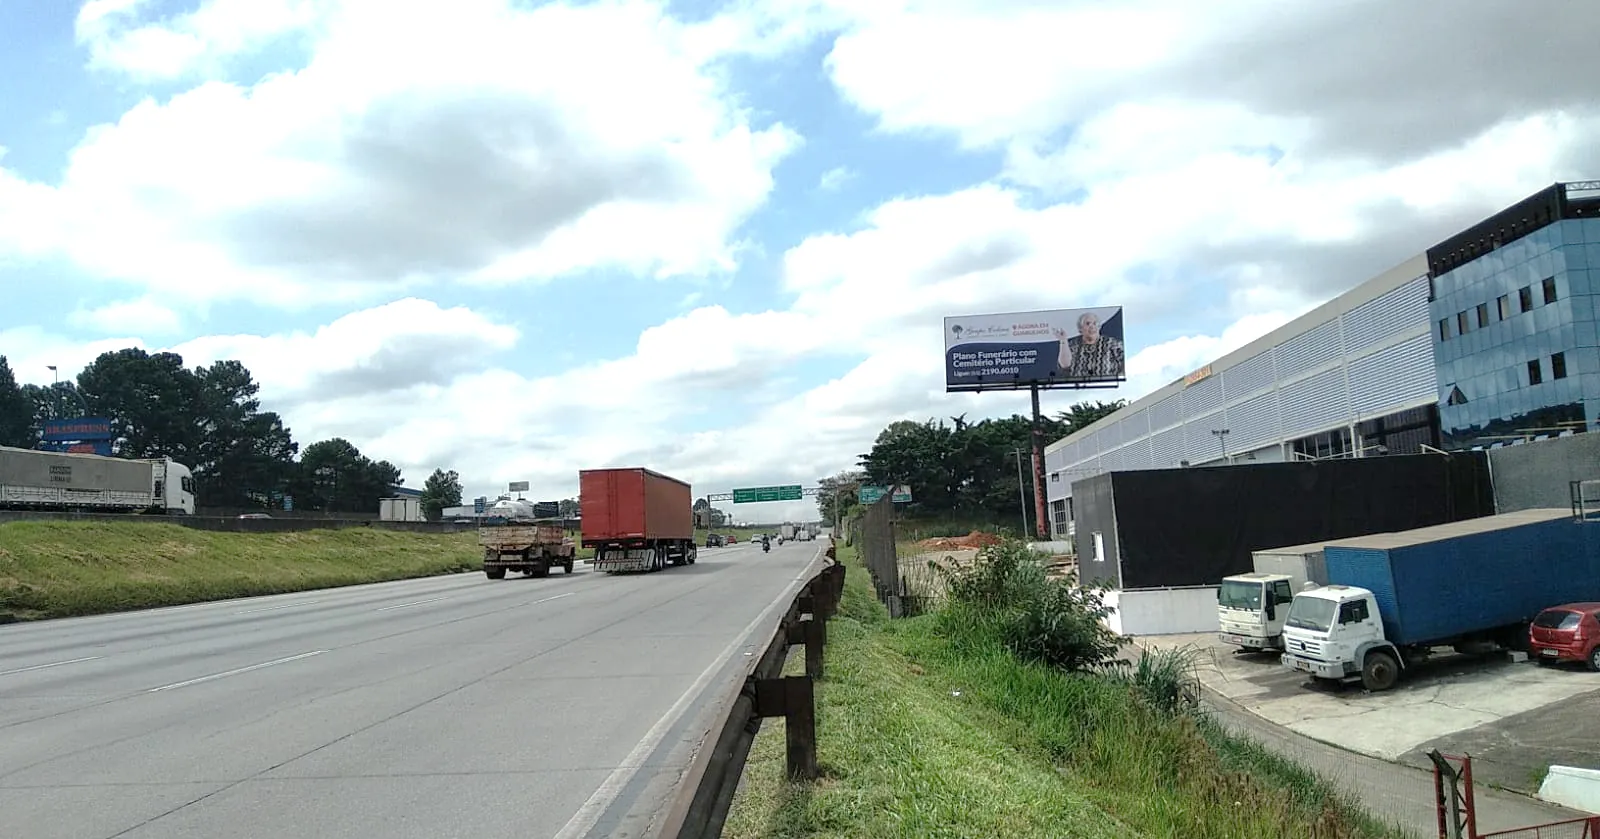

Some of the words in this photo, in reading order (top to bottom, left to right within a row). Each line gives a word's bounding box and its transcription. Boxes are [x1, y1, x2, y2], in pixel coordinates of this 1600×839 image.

[953, 352, 976, 360] Plano
[978, 350, 1017, 359] Funerário
[953, 358, 994, 367] Cemitério
[995, 357, 1036, 365] Particular
[981, 367, 1019, 376] 2190.6010
